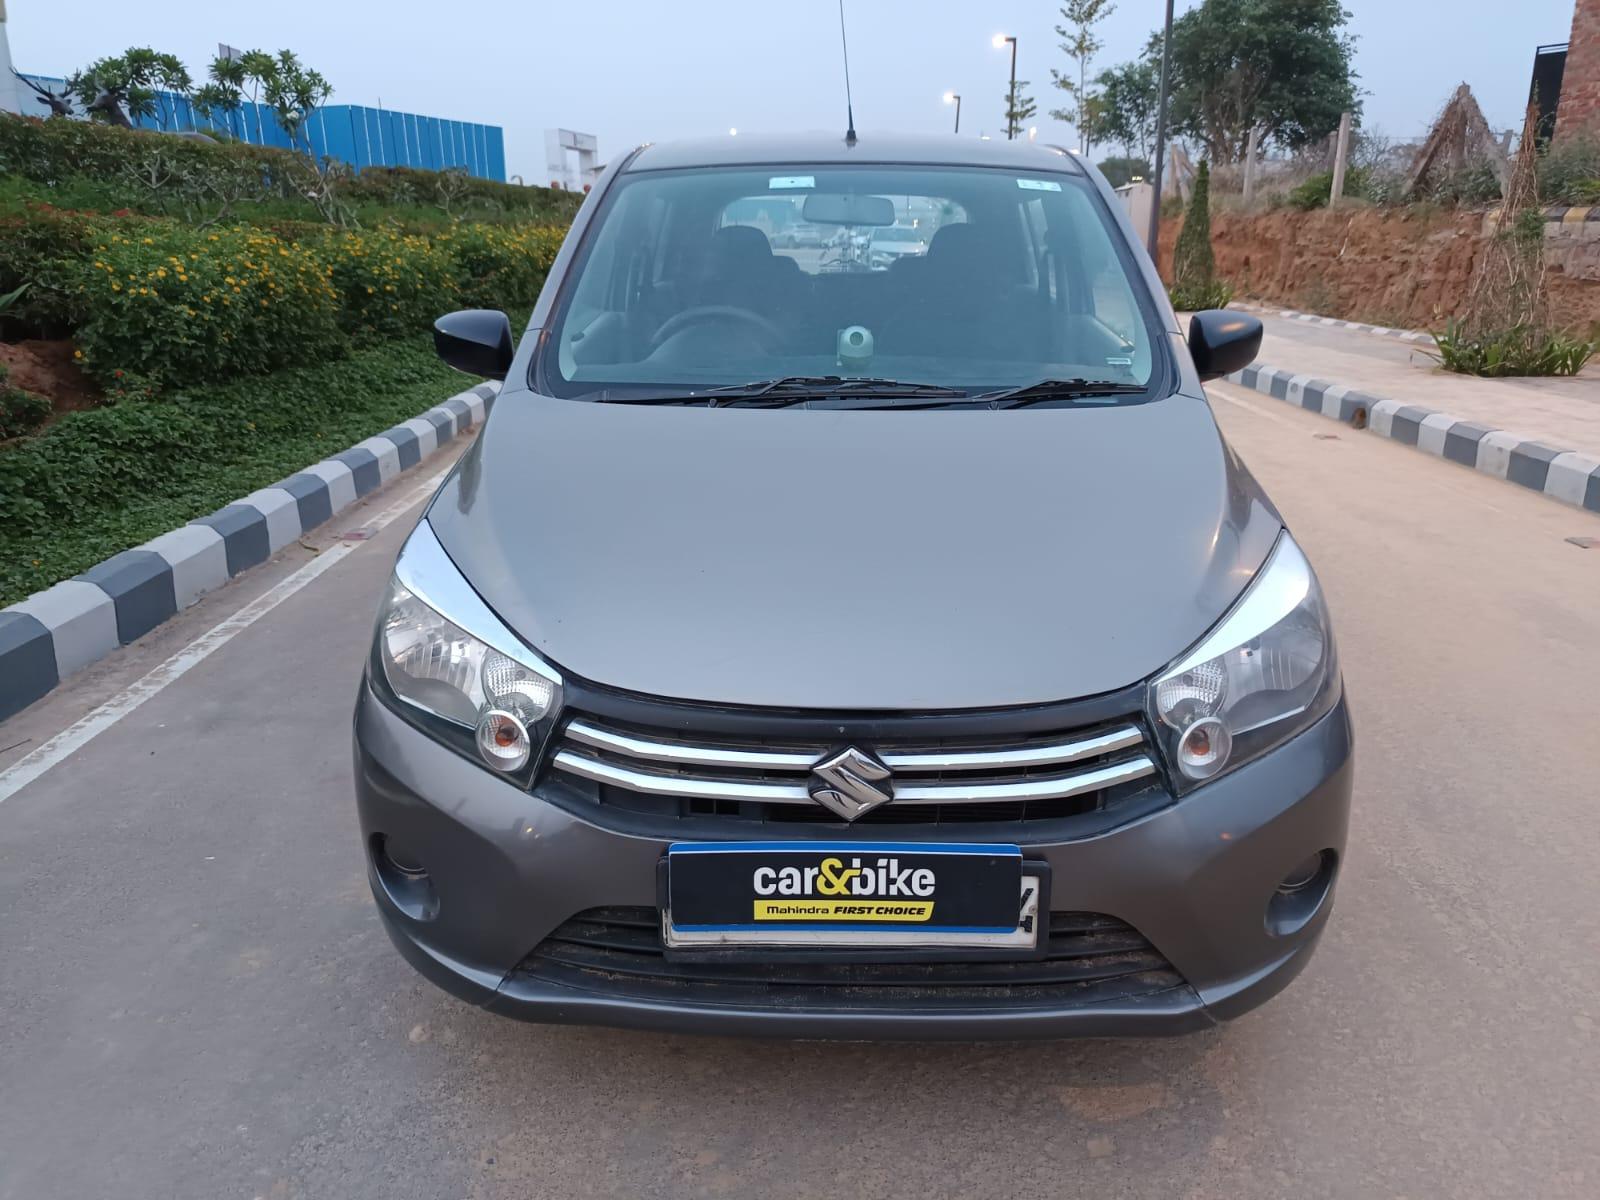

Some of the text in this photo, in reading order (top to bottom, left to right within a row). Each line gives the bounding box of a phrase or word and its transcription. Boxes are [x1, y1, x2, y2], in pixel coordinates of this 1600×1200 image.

[753, 857, 936, 897] car&bike
[766, 905, 926, 916] Mahindra FIRST CHOICE
